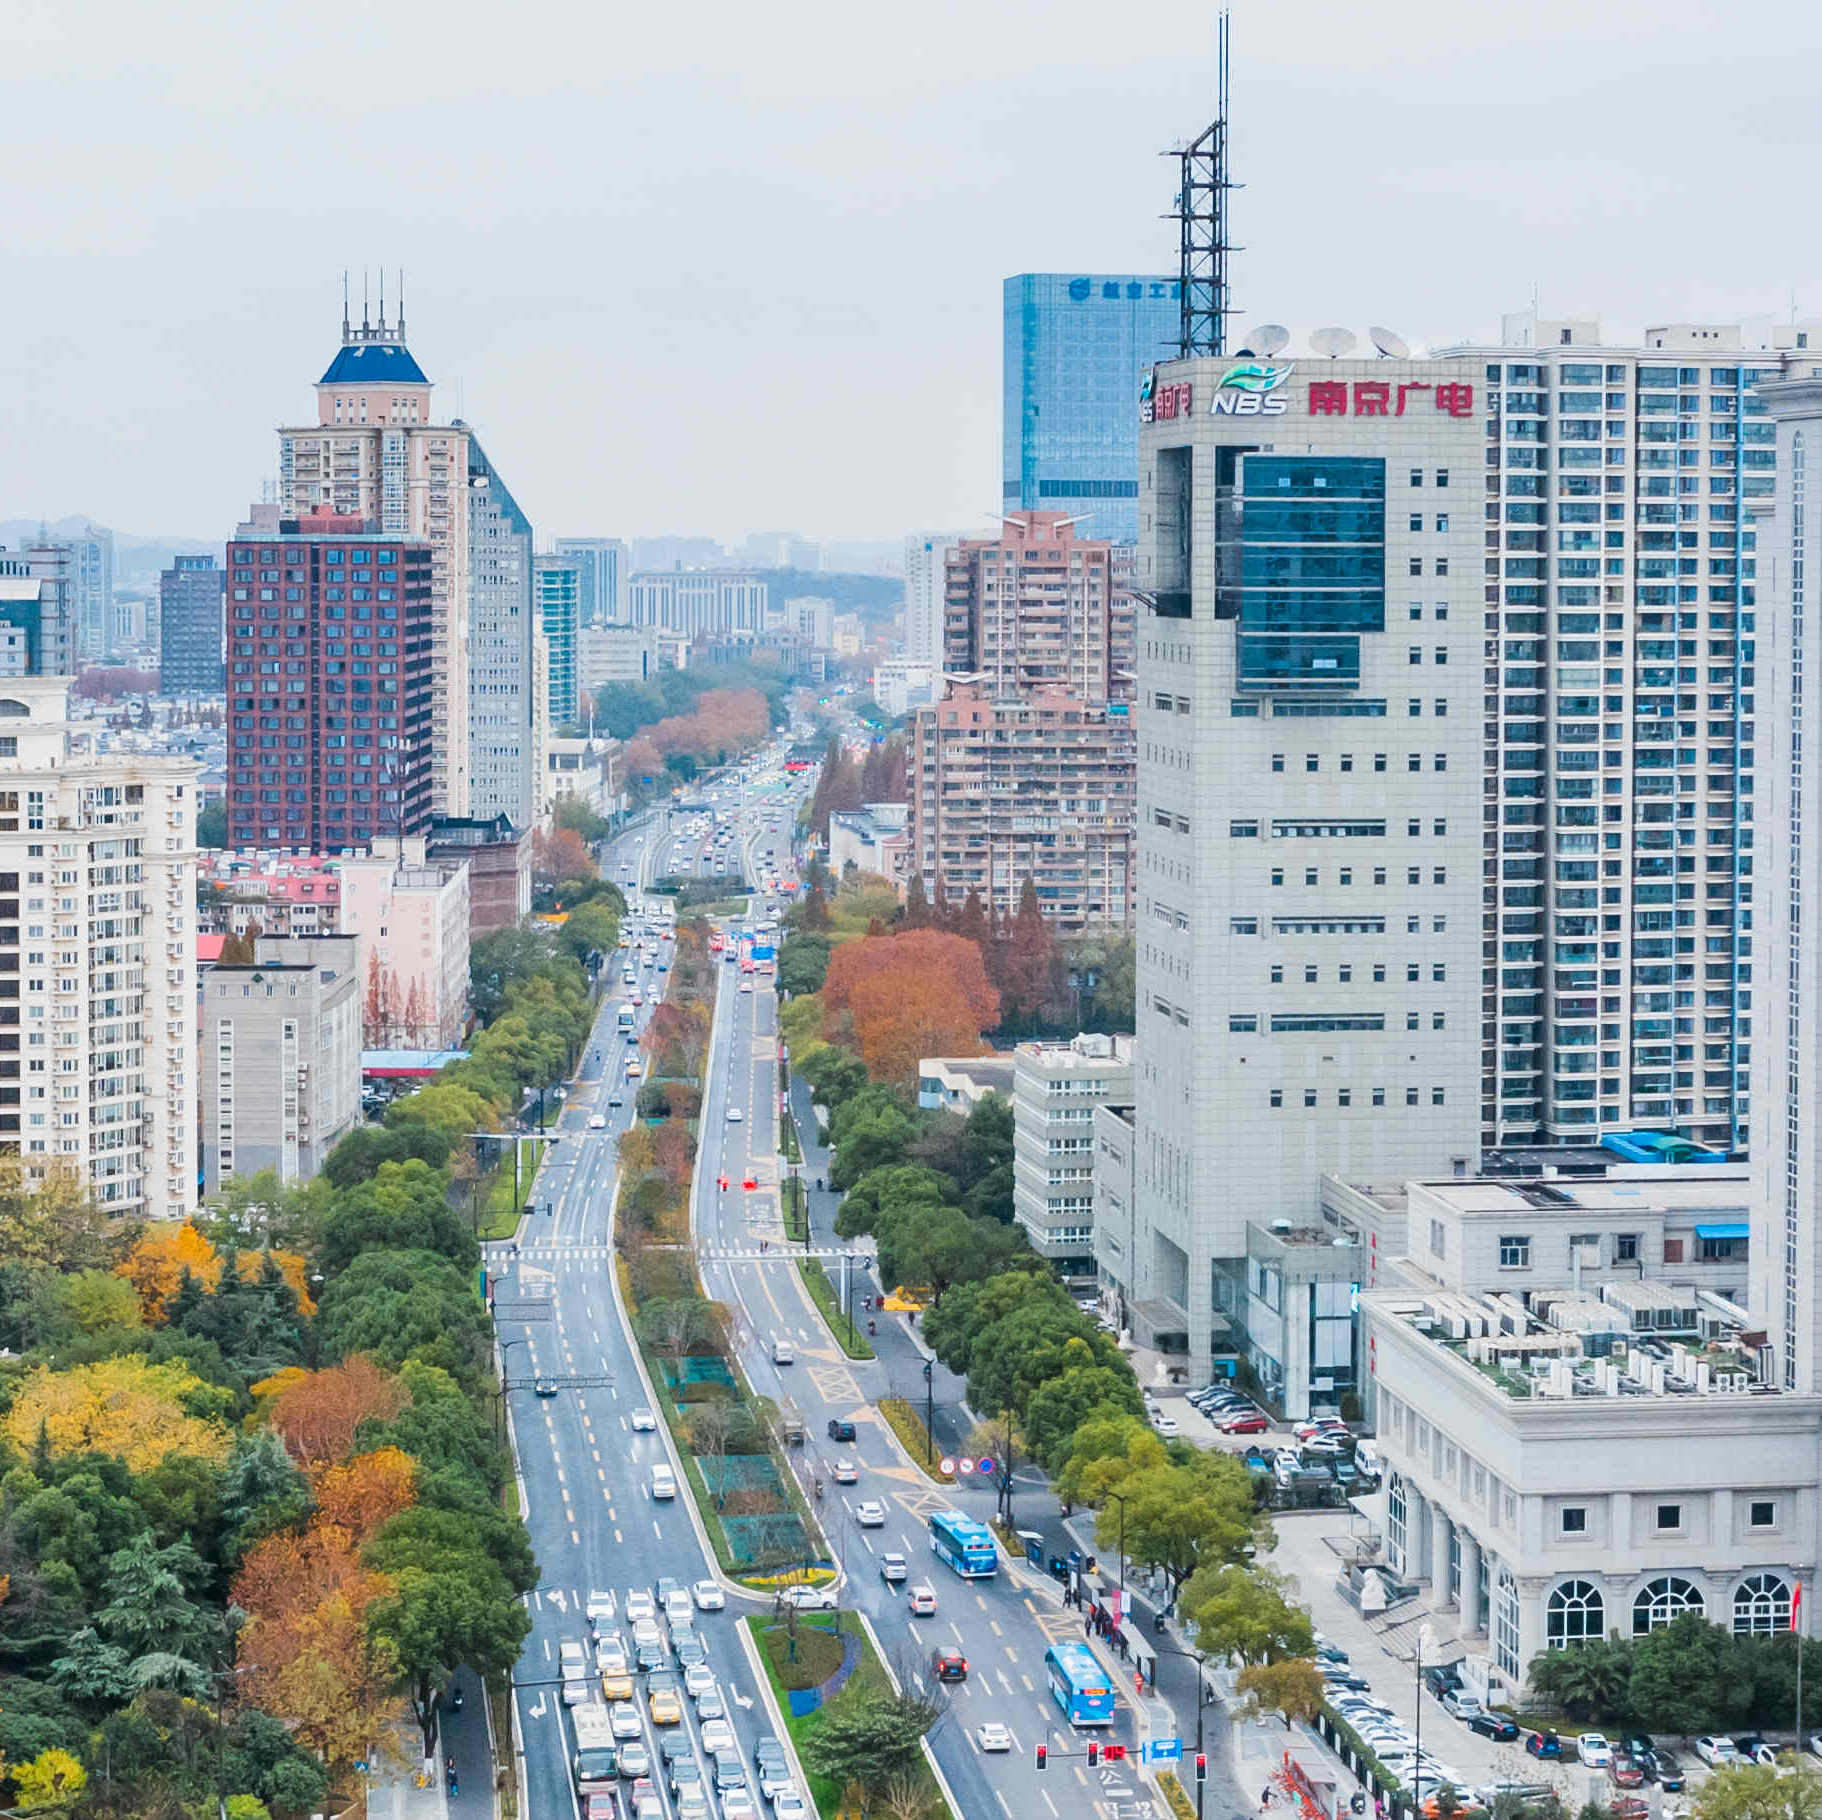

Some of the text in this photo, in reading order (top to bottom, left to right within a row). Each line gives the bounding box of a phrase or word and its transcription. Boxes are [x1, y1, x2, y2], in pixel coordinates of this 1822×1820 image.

[1211, 392, 1290, 417] NBS
[1308, 381, 1474, 417] 南京广电
